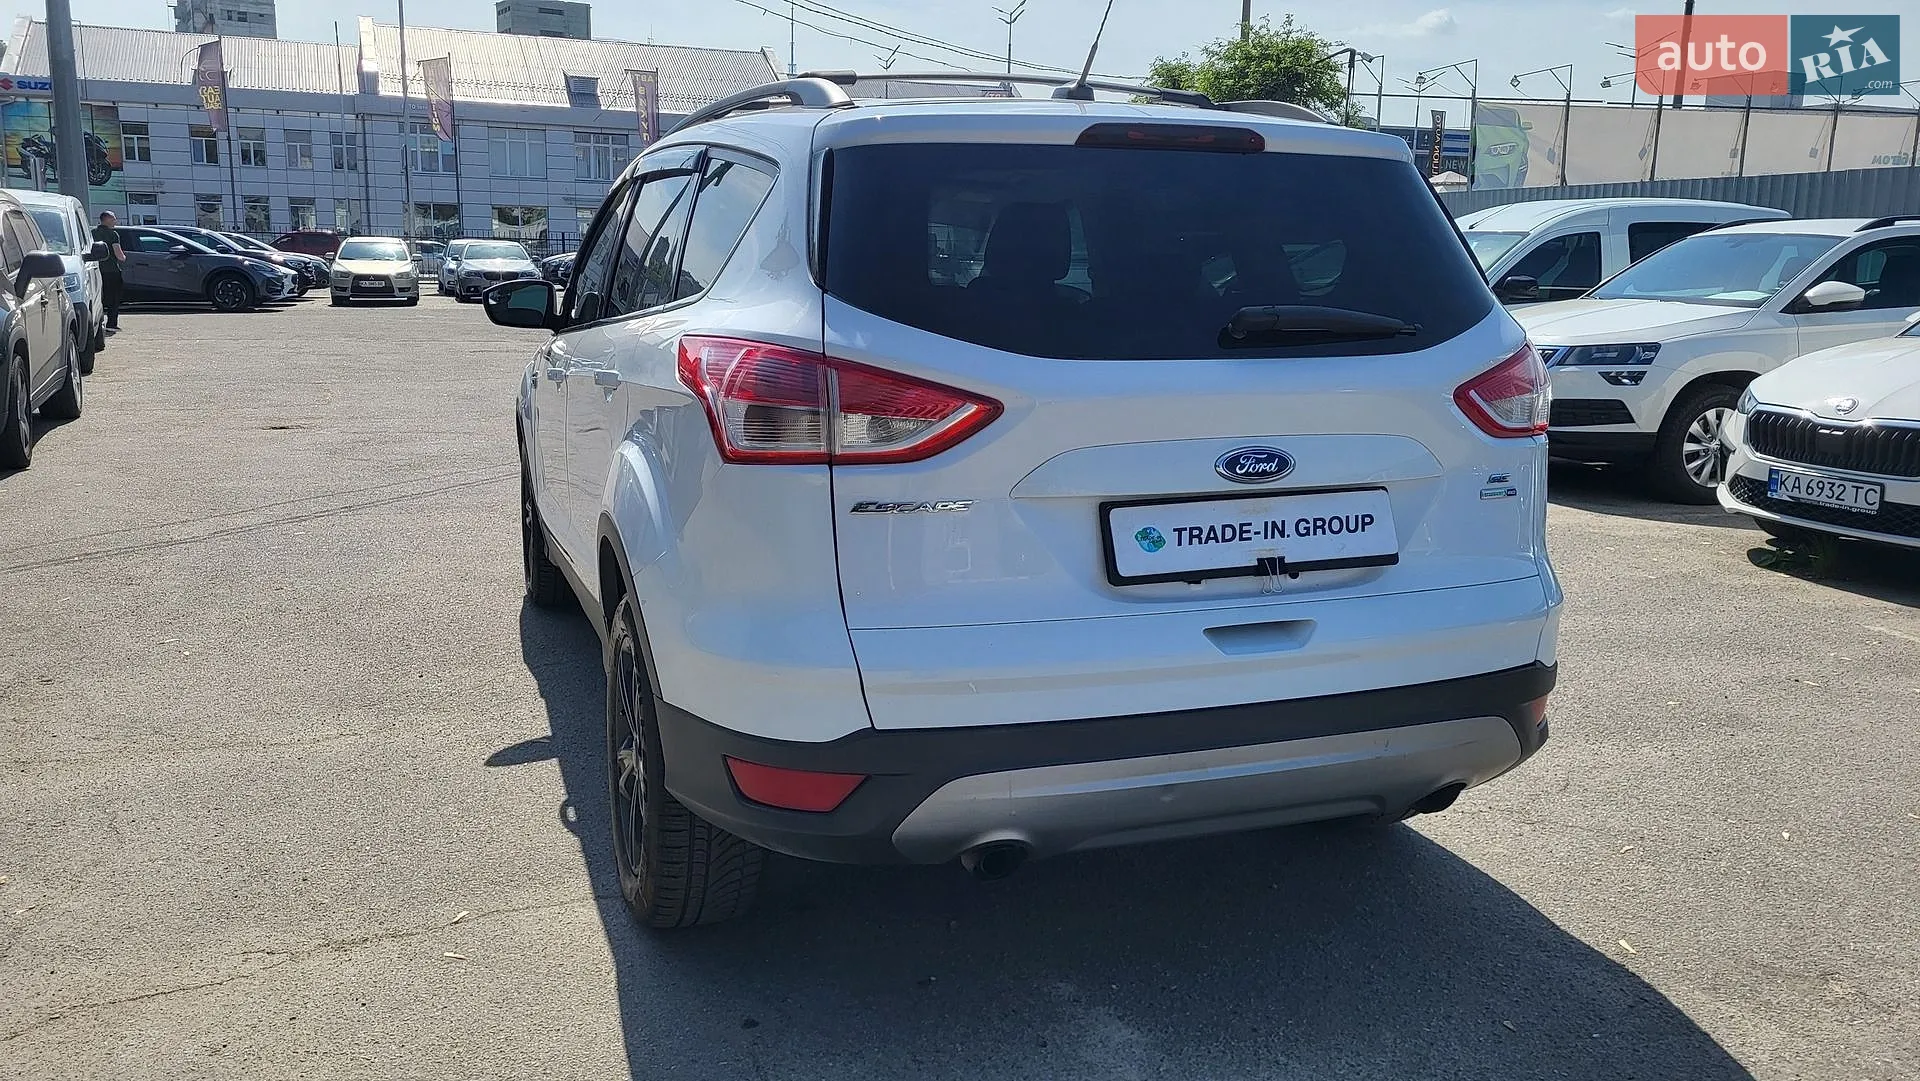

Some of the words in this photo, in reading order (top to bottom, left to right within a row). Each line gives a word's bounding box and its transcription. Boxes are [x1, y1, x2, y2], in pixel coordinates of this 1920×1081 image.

[1445, 159, 1466, 169] NEW
[1235, 454, 1278, 474] Ford
[1779, 473, 1801, 494] KA
[1805, 479, 1847, 502] 6932
[1851, 485, 1879, 506] TC
[1294, 513, 1375, 538] GROUP
